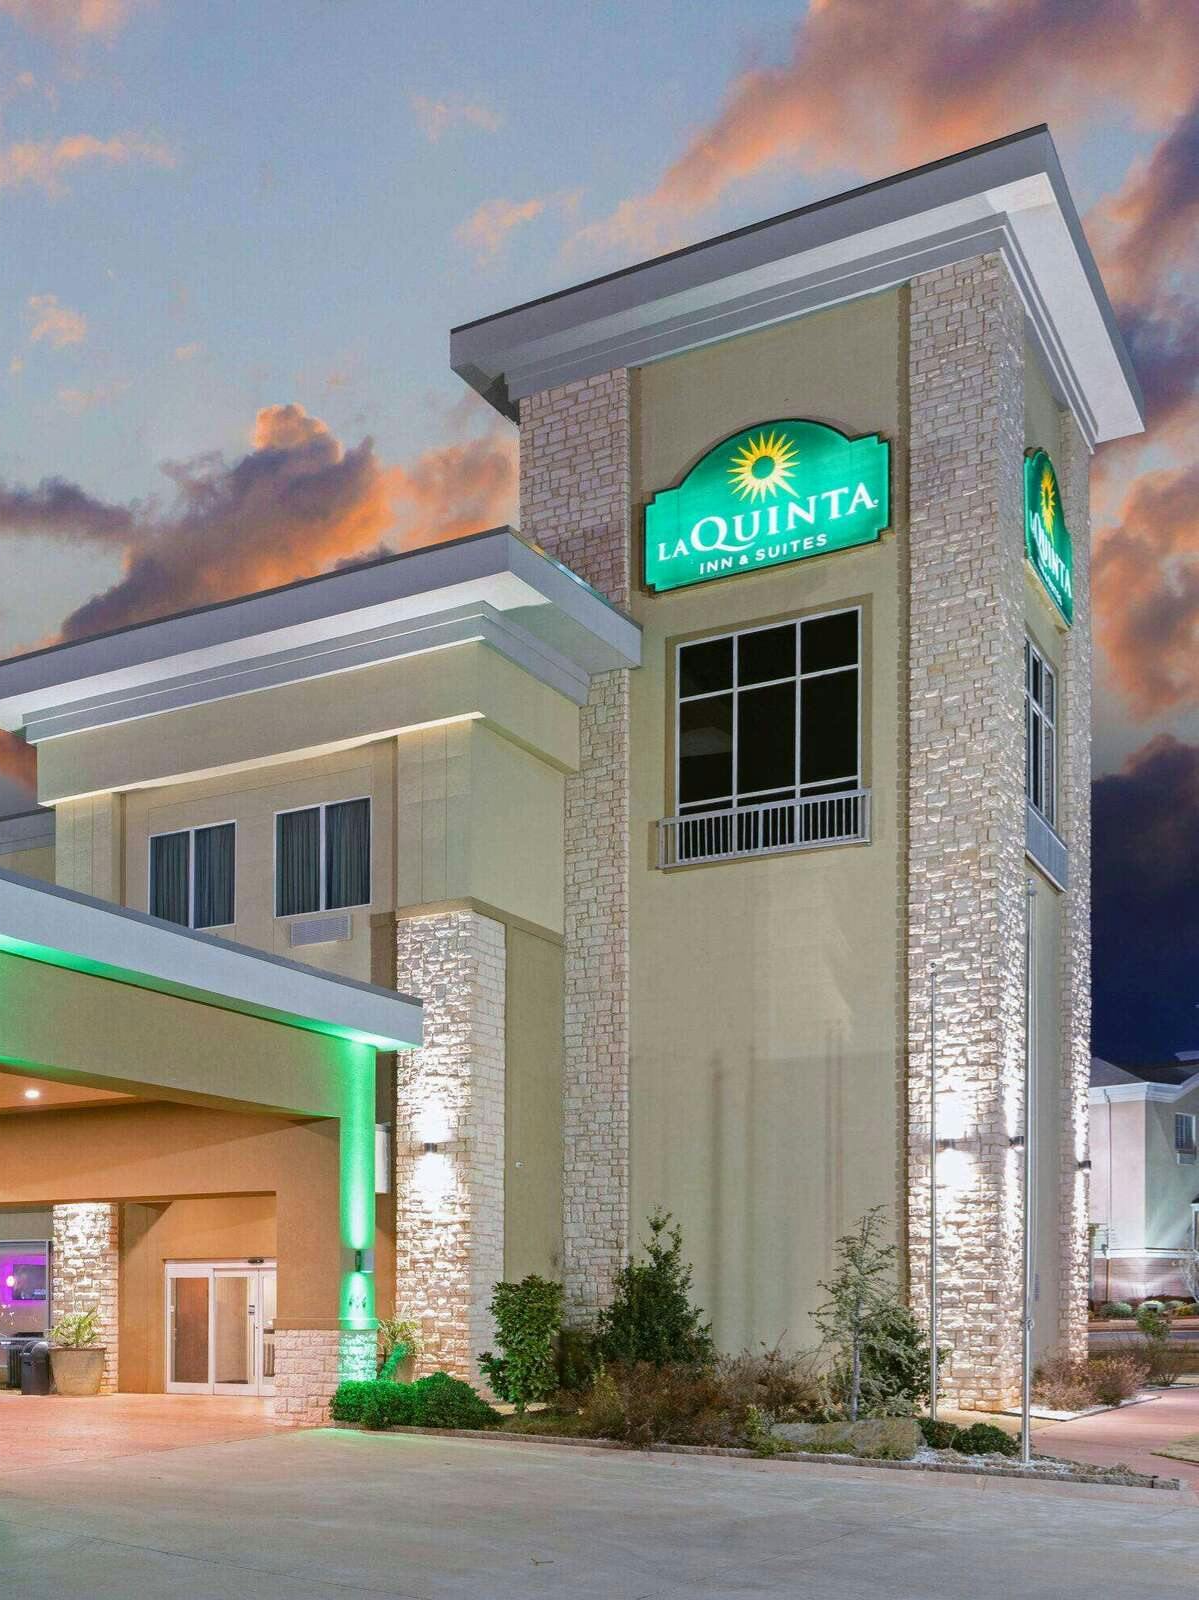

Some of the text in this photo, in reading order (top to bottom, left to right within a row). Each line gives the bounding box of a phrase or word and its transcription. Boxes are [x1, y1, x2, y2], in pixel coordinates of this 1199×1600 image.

[658, 482, 878, 561] LA QUINTA
[700, 533, 828, 575] INN & SUITES
